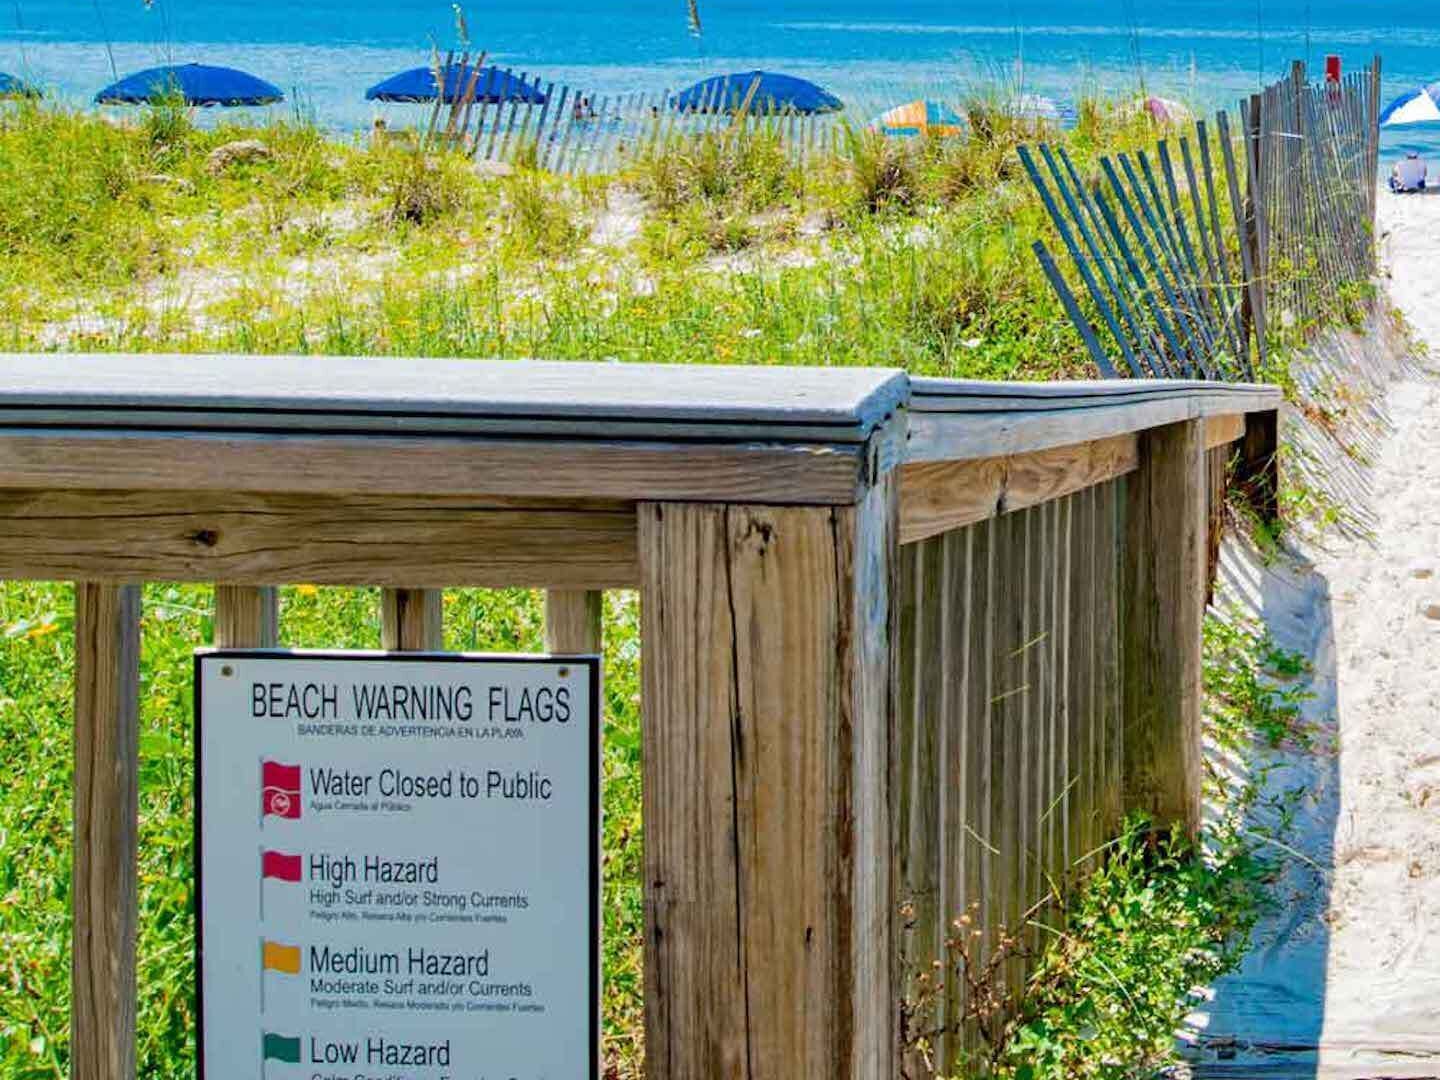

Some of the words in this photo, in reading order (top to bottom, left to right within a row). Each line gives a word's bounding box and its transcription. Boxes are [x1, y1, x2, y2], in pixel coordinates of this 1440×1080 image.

[252, 683, 338, 718] BEACH
[353, 684, 472, 721] WARNING
[489, 686, 570, 723] FLAGS
[298, 724, 357, 736] BANDERAS
[361, 725, 376, 736] DE
[377, 725, 455, 738] ADVERTENCIA
[458, 726, 473, 738] EN
[491, 727, 524, 738] PLAYA
[310, 768, 372, 796] Water
[379, 769, 452, 798] Closed
[460, 772, 479, 798] to
[487, 770, 552, 800] Public
[310, 855, 356, 888] High
[364, 855, 438, 883] Hazard
[310, 889, 340, 907] High
[345, 889, 372, 905] Surf
[375, 891, 418, 906] and/or
[423, 891, 466, 910] Strong
[471, 891, 529, 908] Currents
[310, 946, 399, 973] Medium
[408, 947, 488, 976] Hazard
[310, 979, 379, 994] Moderate
[383, 979, 414, 995] Surf
[418, 980, 464, 997] and/or
[468, 980, 532, 997] Currents
[311, 1037, 358, 1063] Low
[367, 1037, 449, 1066] Hazard
